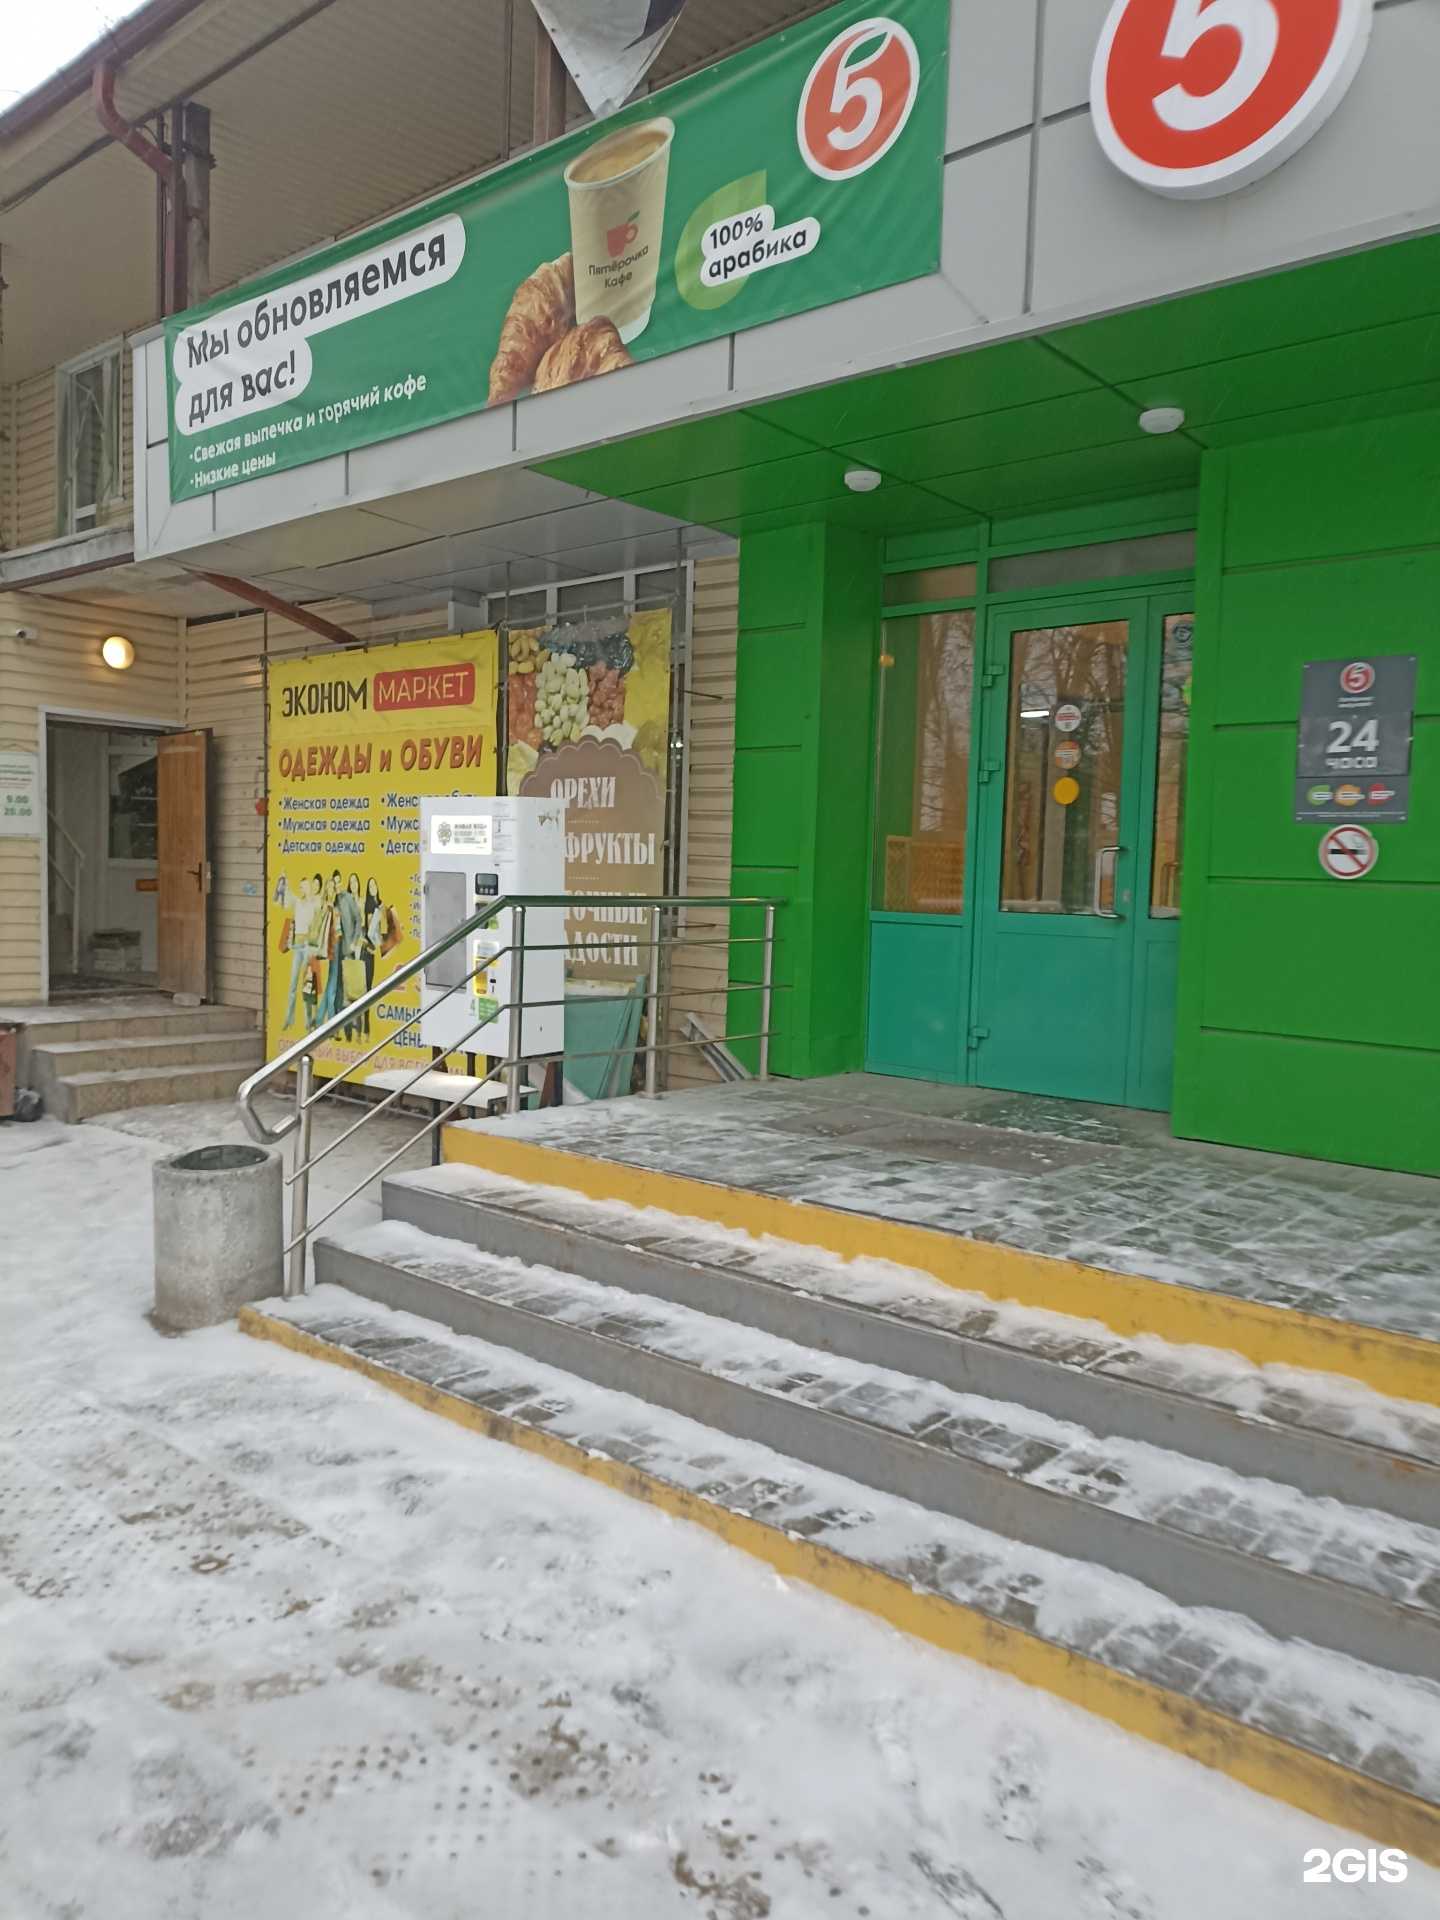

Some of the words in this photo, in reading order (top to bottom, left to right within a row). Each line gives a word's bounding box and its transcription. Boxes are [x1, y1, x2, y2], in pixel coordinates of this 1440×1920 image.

[1152, 0, 1280, 131] 5
[827, 32, 892, 151] 5
[709, 213, 764, 250] 100%
[708, 227, 808, 279] арабика
[604, 271, 633, 289] Кафе
[187, 330, 229, 368] Мы
[237, 234, 446, 349] обновляемся
[189, 381, 233, 428] для
[241, 350, 296, 403] вас!
[244, 415, 302, 447] выпечка
[306, 412, 316, 428] и
[319, 386, 380, 425] горячий
[384, 373, 427, 403] кофе
[242, 451, 276, 475] цены
[282, 677, 368, 718] ЭКОНОМ
[378, 671, 469, 704] МАРКЕТ
[1326, 719, 1379, 753] 24
[279, 742, 373, 782] ОДЕЖДЫ
[400, 734, 484, 772] ОБУВИ
[283, 797, 327, 810] Женская
[329, 798, 370, 810] одежда
[386, 793, 419, 808] Женс
[550, 776, 616, 808] ОРЕХИ
[282, 817, 327, 834] Мужская
[330, 820, 370, 832] одежда
[386, 815, 420, 834] Мужс
[282, 839, 321, 853] Детская
[325, 841, 365, 854] одежда
[386, 838, 420, 855] Детск
[564, 832, 656, 865] ФРУКТЫ
